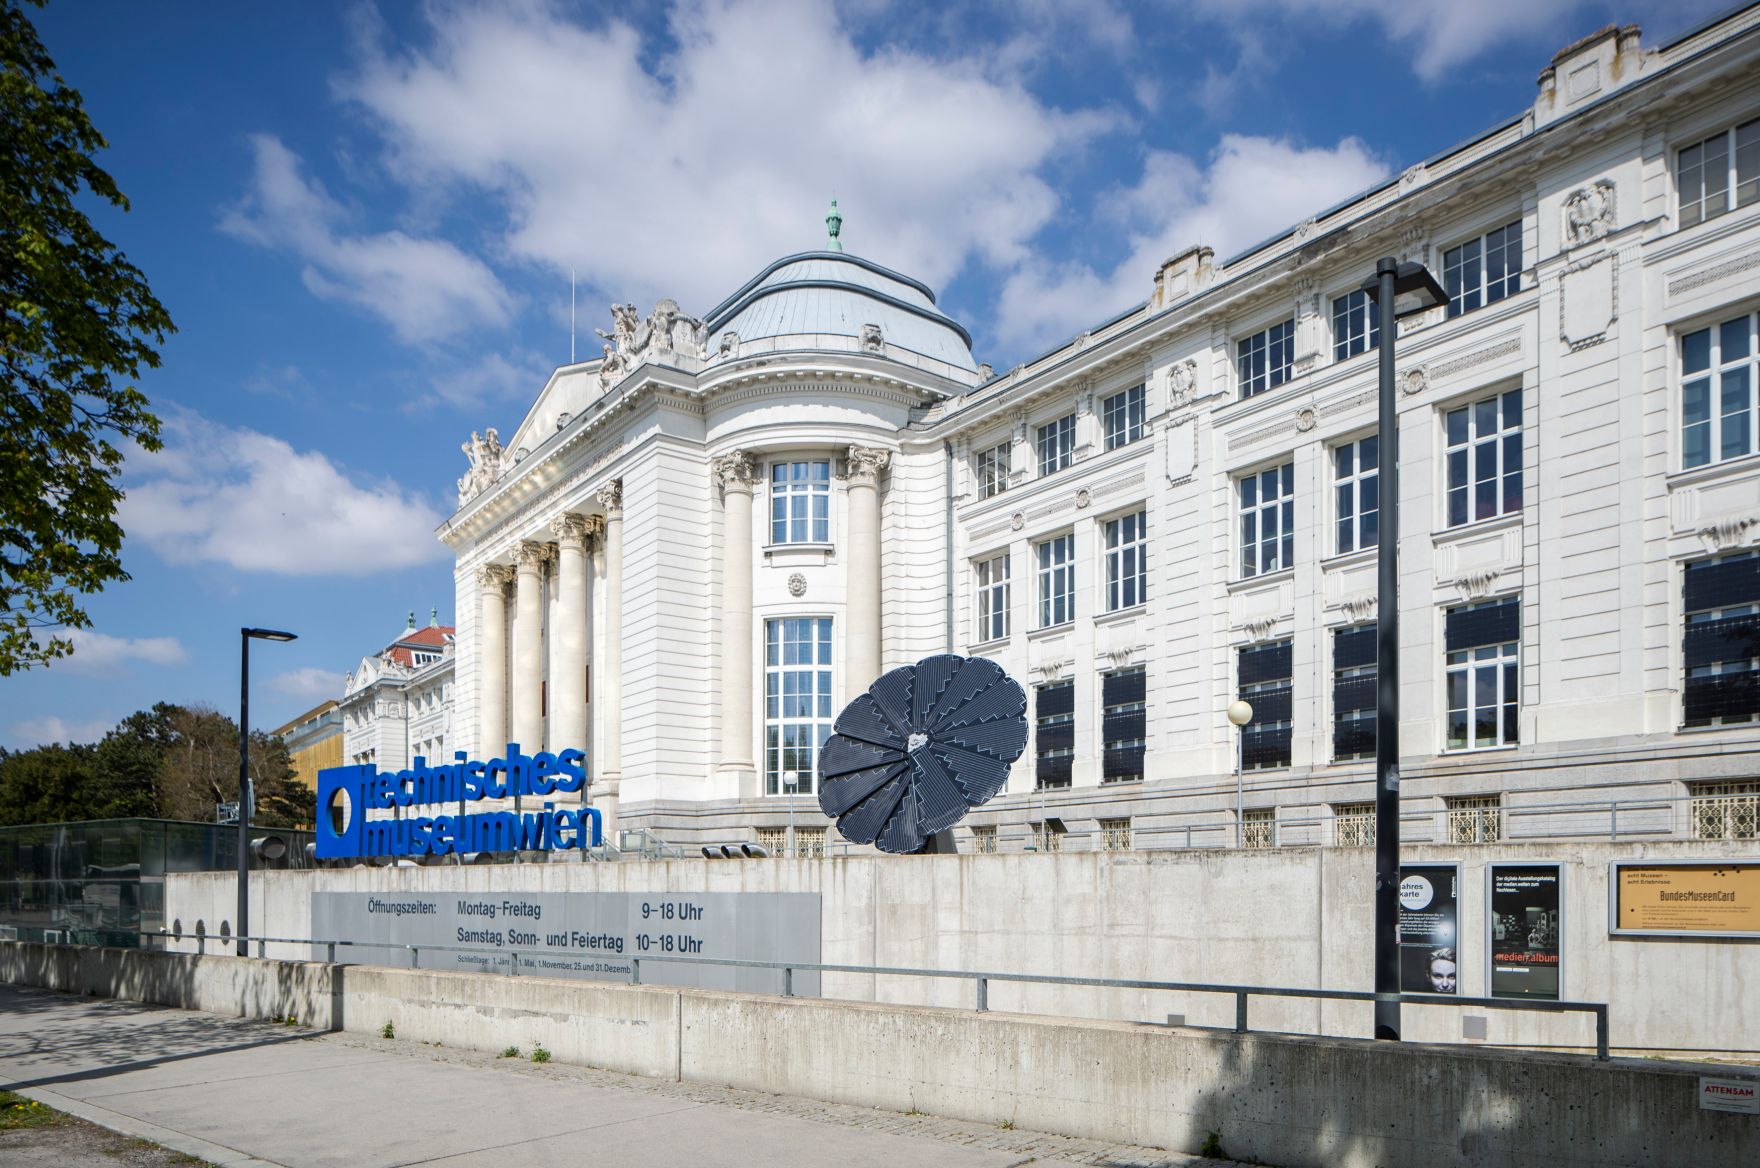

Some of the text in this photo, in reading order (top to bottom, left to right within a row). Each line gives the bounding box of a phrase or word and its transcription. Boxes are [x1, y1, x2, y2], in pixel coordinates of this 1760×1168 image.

[361, 743, 586, 809] technisches
[1660, 890, 1735, 902] BundesMuseenCard
[368, 897, 437, 916] Öffnungszeiten:
[678, 902, 703, 921] Uhr
[457, 927, 505, 947] Samstag,
[508, 929, 541, 946] Sonn-
[546, 931, 568, 947] und
[571, 931, 624, 953] Feiertag
[678, 935, 703, 953] Uhr
[1704, 1085, 1754, 1096] ATTENSAM
